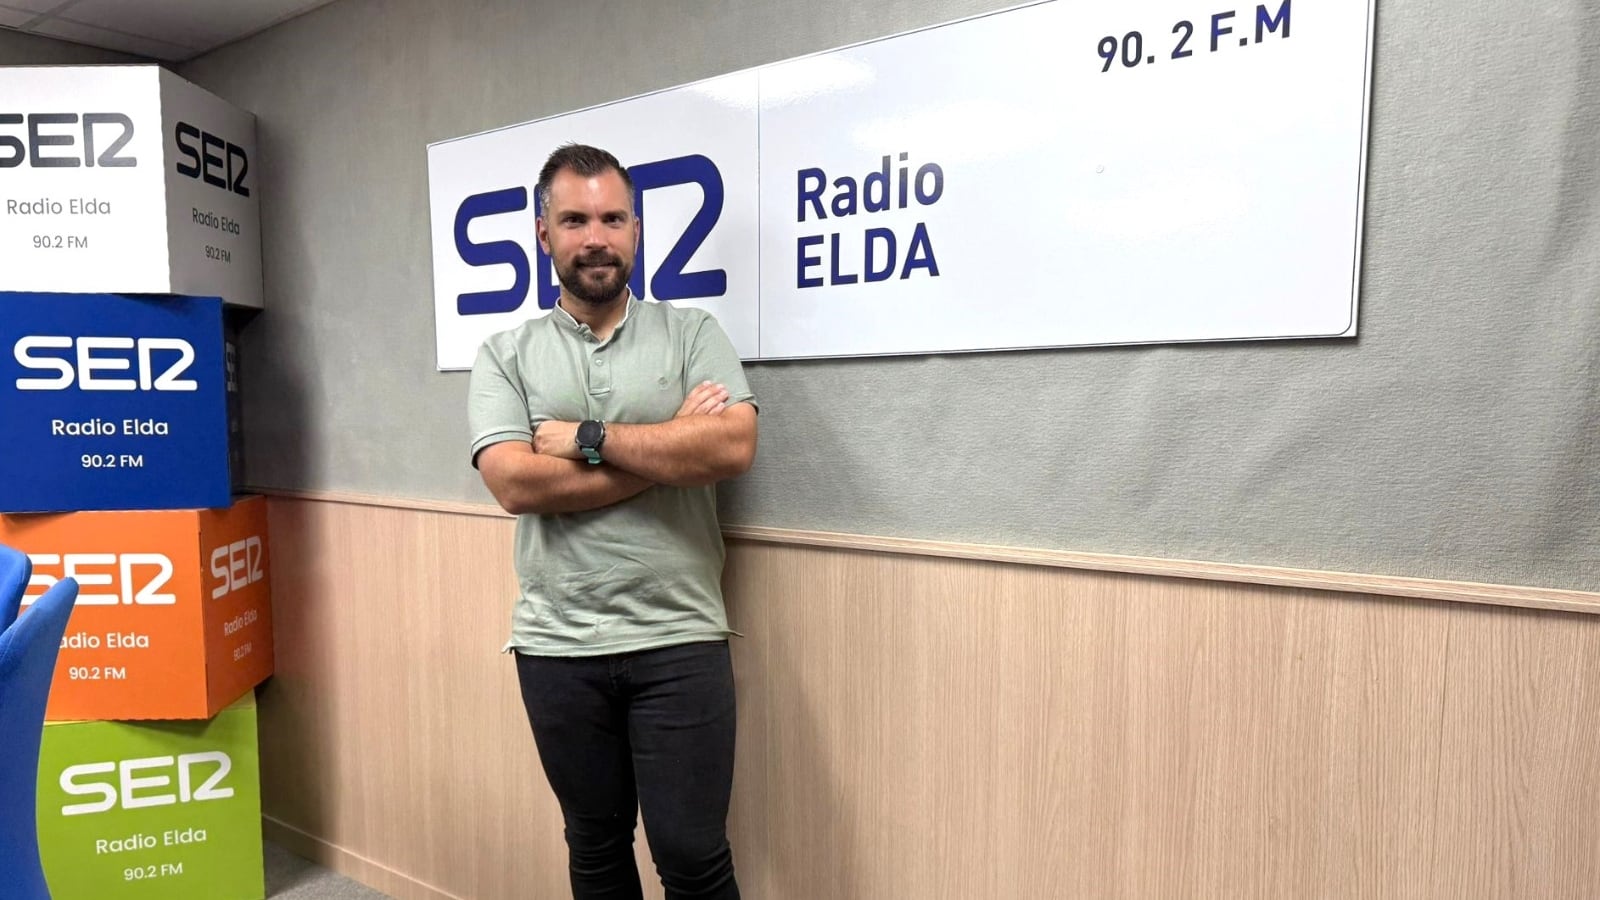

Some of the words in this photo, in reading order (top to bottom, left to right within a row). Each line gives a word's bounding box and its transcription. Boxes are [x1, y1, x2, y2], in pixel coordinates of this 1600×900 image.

[175, 121, 250, 198] SER
[797, 152, 945, 222] Radio
[7, 198, 63, 216] Radio
[70, 198, 112, 216] Elda
[192, 207, 219, 230] Radio
[221, 214, 240, 236] Elda
[453, 153, 727, 317] SR
[33, 235, 64, 249] 90.2
[67, 235, 88, 249] FM
[205, 244, 220, 260] 90.2
[221, 248, 231, 265] FM
[797, 222, 939, 289] ELDA
[14, 335, 198, 391] SER
[52, 418, 116, 436] Radio
[123, 418, 169, 436] Elda
[81, 454, 116, 468] 90.2
[120, 454, 144, 468] FM
[210, 535, 264, 601] SER
[59, 632, 100, 649] adio
[106, 632, 150, 649] Elda
[69, 666, 100, 681] 90.2
[104, 666, 127, 681] FM
[59, 750, 235, 817] SER
[96, 833, 157, 855] Radio
[163, 827, 207, 847] Elda
[123, 864, 157, 881] 90.2
[161, 862, 184, 877] FM
